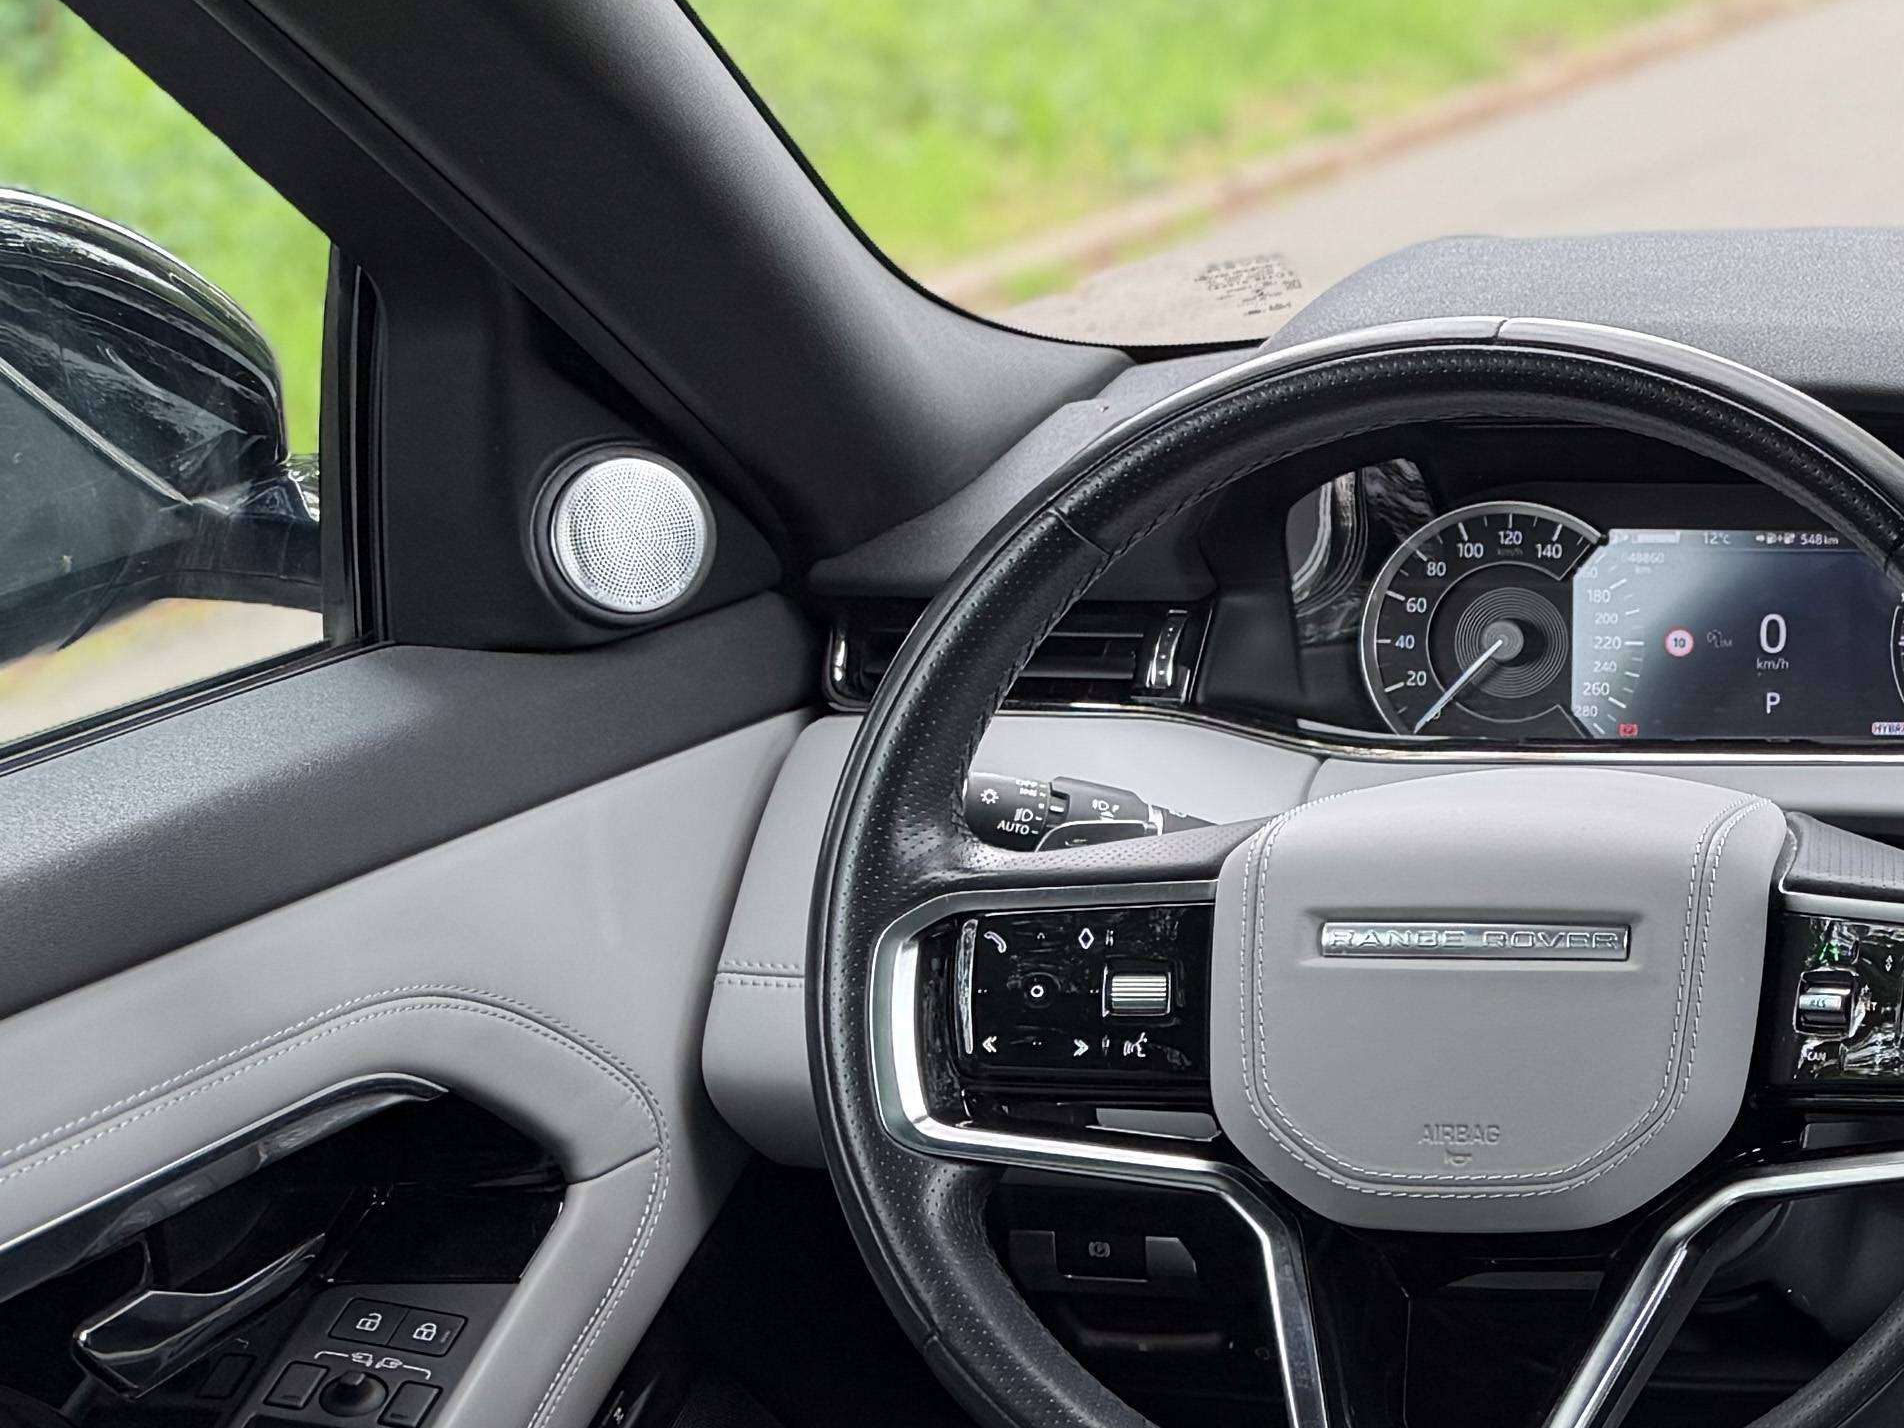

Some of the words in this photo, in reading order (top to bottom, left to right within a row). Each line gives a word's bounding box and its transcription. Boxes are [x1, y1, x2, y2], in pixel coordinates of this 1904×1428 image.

[1498, 531, 1523, 546] 120
[1457, 543, 1484, 559] 100
[1536, 543, 1563, 559] 140
[1426, 561, 1447, 577] 80
[1587, 588, 1611, 604] 180
[1406, 597, 1427, 614] 60
[1594, 612, 1619, 625] 200
[1759, 613, 1788, 654] 0
[1394, 634, 1416, 650] 40
[1594, 636, 1622, 650] 220
[1673, 637, 1687, 648] 10
[1593, 661, 1618, 674] 240
[1756, 658, 1790, 671] km/h
[1407, 670, 1427, 686] 20
[1582, 682, 1611, 697] 260
[1766, 692, 1781, 714] P
[1575, 705, 1599, 718] 280
[997, 820, 1030, 835] AUTO
[1329, 929, 1466, 950] RANGE
[1482, 930, 1619, 950] ROVER
[1418, 1124, 1500, 1145] AIRBAG
